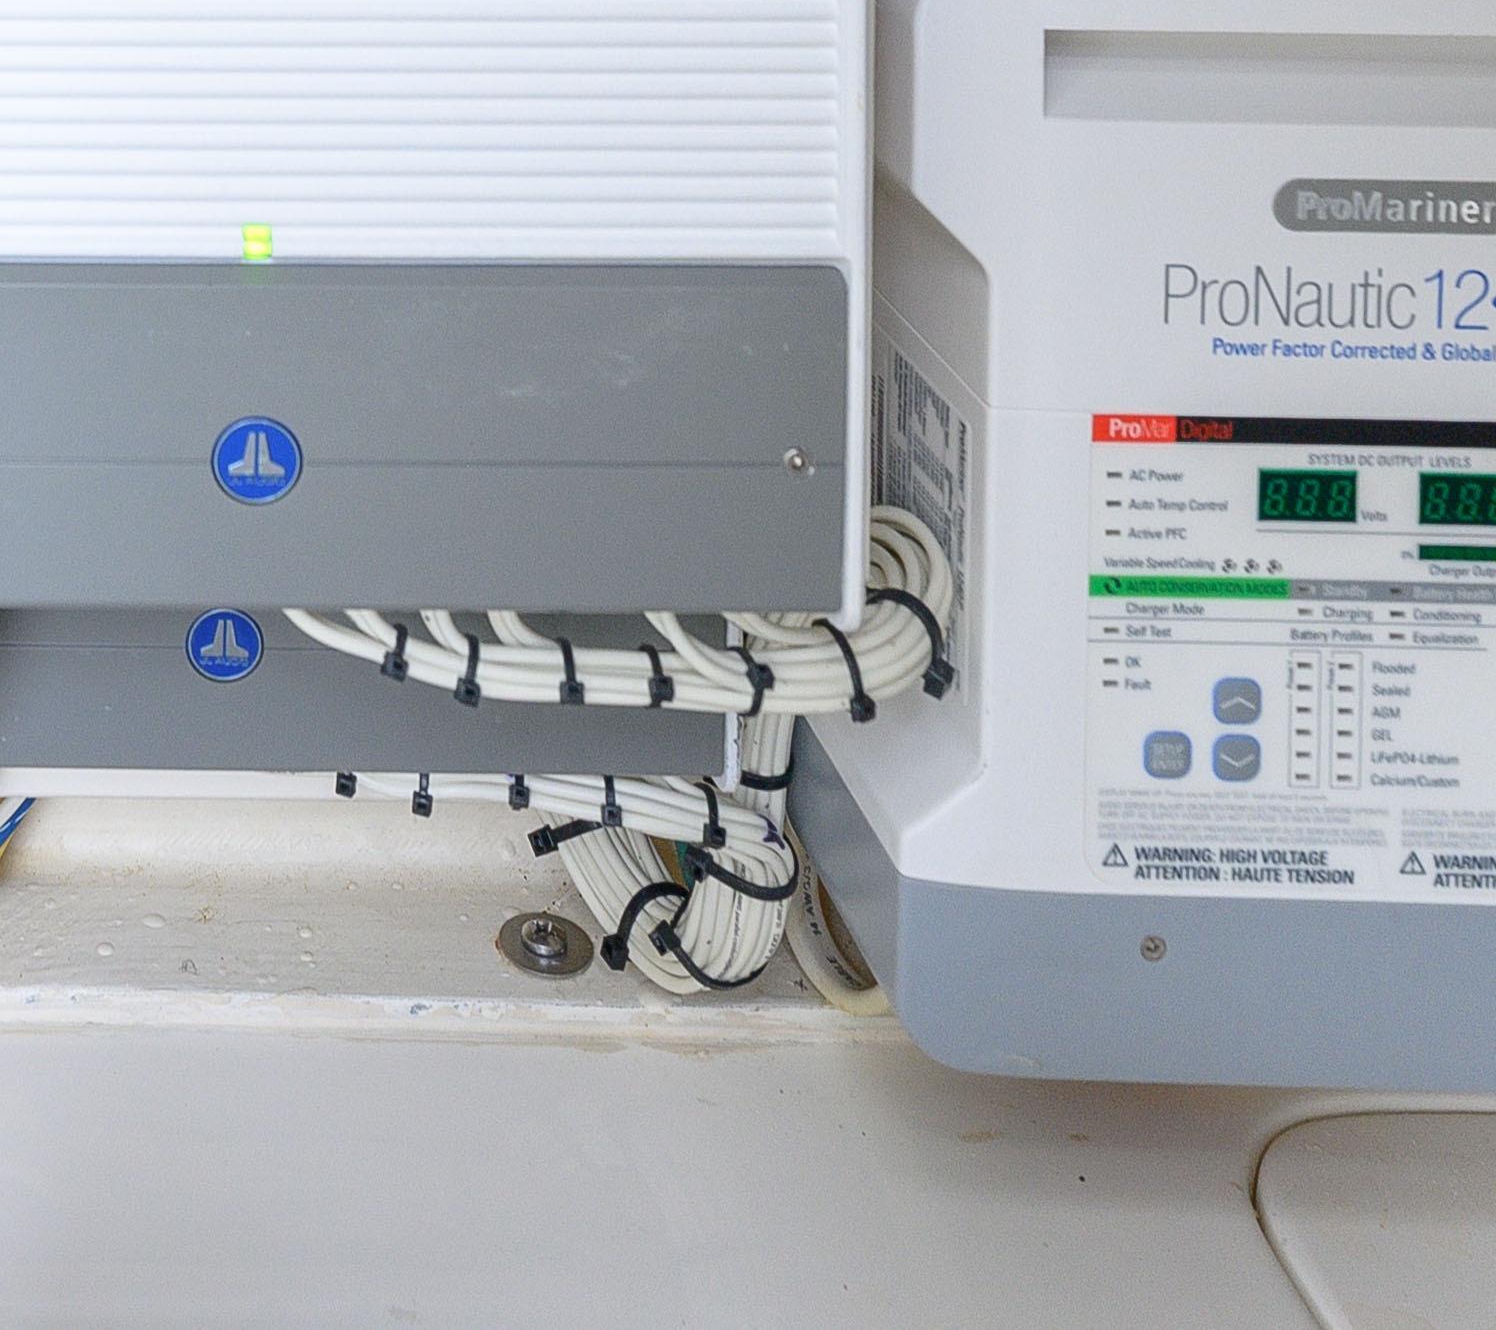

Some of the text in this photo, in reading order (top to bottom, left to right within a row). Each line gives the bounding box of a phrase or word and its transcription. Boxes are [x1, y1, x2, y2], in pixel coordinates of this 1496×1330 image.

[1213, 338, 1267, 359] Power
[1272, 340, 1325, 359] Factor
[1332, 341, 1417, 361] Corrected
[1422, 342, 1436, 361] &
[1441, 343, 1496, 362] Global
[1307, 453, 1472, 469] SYSTEM DC OUTPUT LEVELS
[1129, 470, 1184, 483] AC Power
[1127, 499, 1228, 513] Auto Temp Control
[1361, 511, 1388, 522] Volts
[1127, 527, 1187, 540] Active PFC
[1104, 557, 1145, 569] Variable
[1145, 558, 1177, 572] Speed
[1428, 564, 1469, 578] Charger
[1126, 602, 1205, 617] Charger Mode
[1322, 607, 1373, 621] Charging
[1412, 609, 1482, 624] Conditioning
[1125, 625, 1172, 638] Self Test
[1290, 628, 1373, 643] Battery Profiles
[1412, 631, 1479, 645] Equalization
[1133, 845, 1329, 866] WARNING: HIGH VOLTAGE
[1134, 863, 1221, 882] ATTENTION
[1231, 867, 1281, 883] HAUTE
[1287, 869, 1355, 885] TENSION
